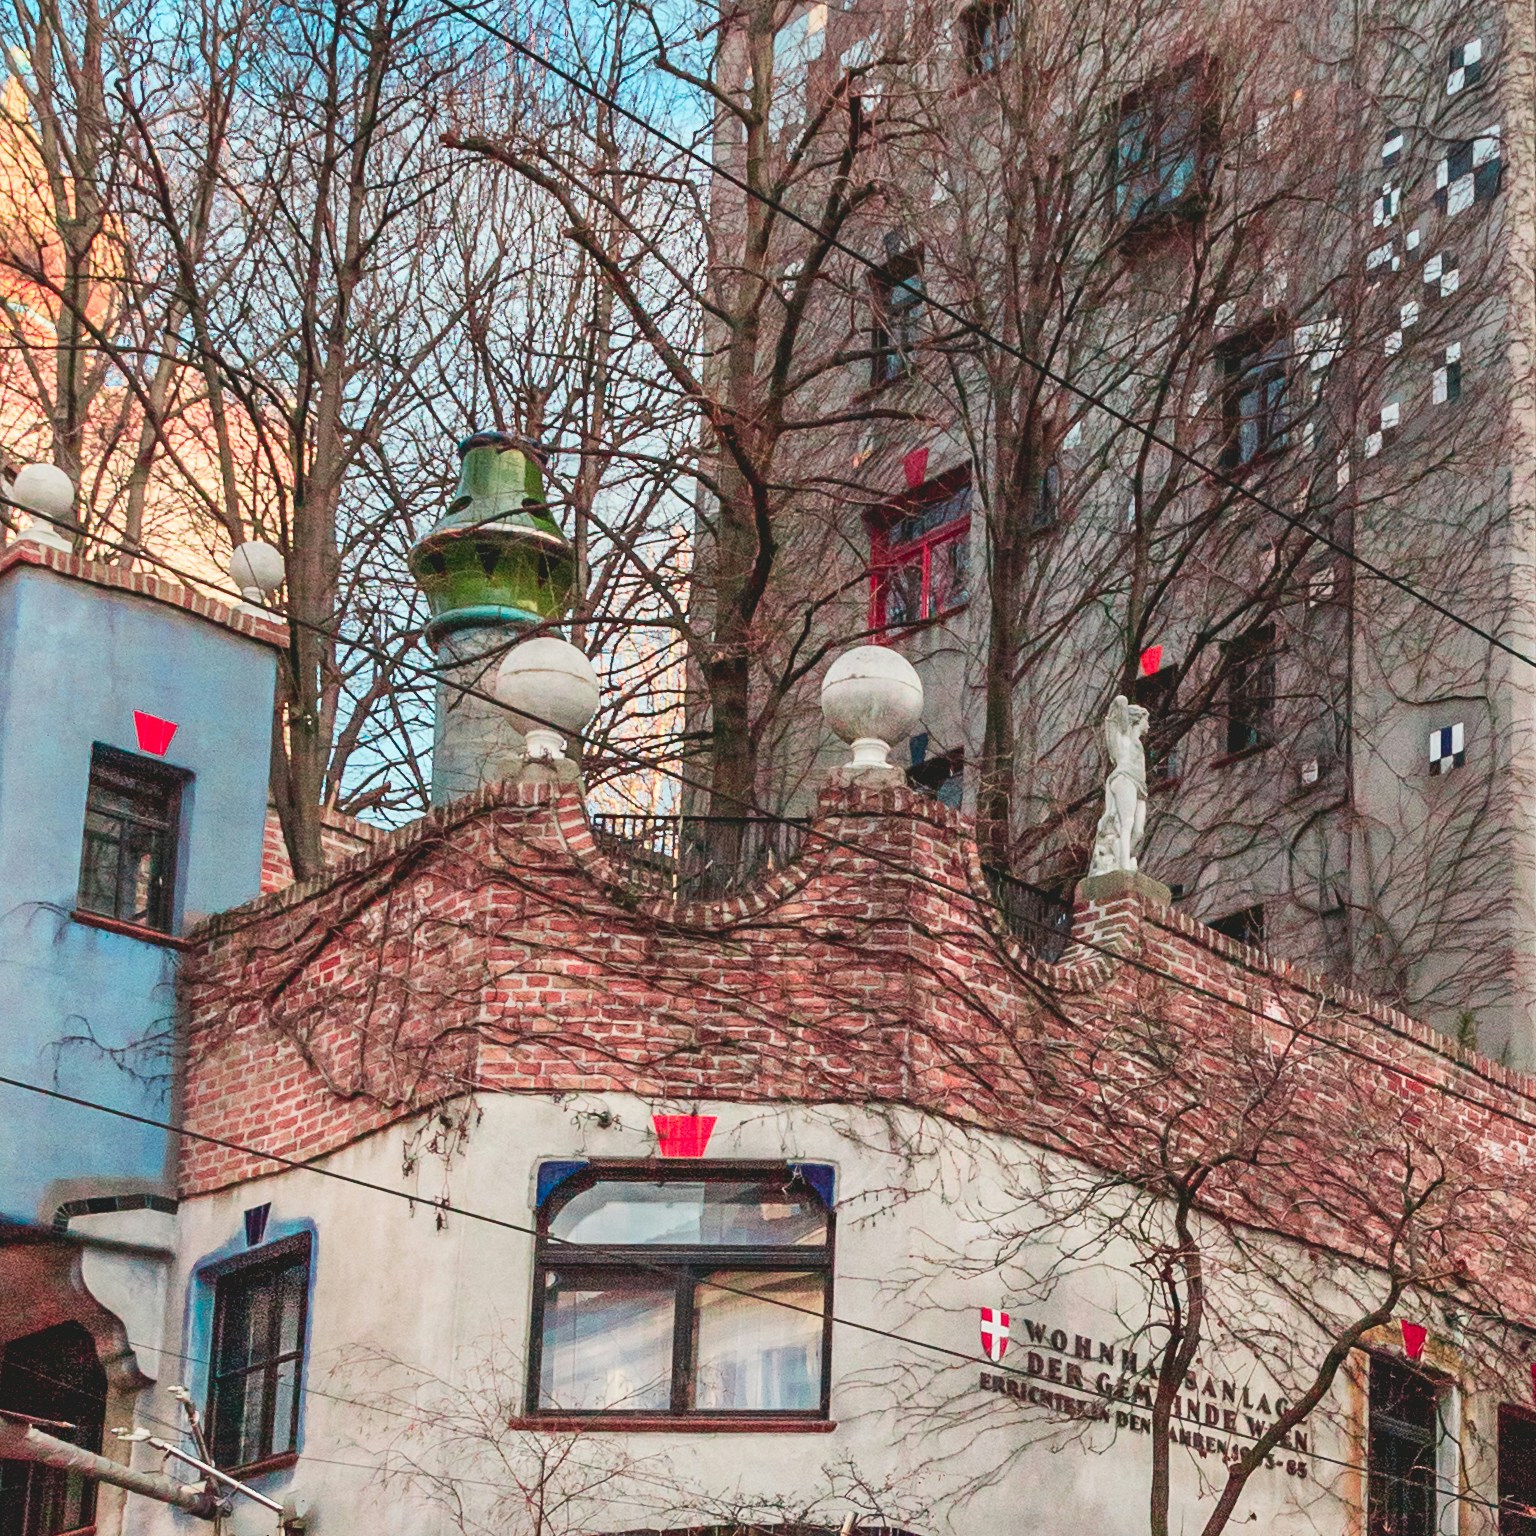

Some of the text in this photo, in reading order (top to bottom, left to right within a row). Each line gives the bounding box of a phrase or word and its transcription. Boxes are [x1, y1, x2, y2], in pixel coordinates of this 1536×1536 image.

[1027, 1351, 1308, 1452] DER GEMINDE WEN
[1116, 1410, 1151, 1434] DEN
[1168, 1426, 1227, 1454] AHREN
